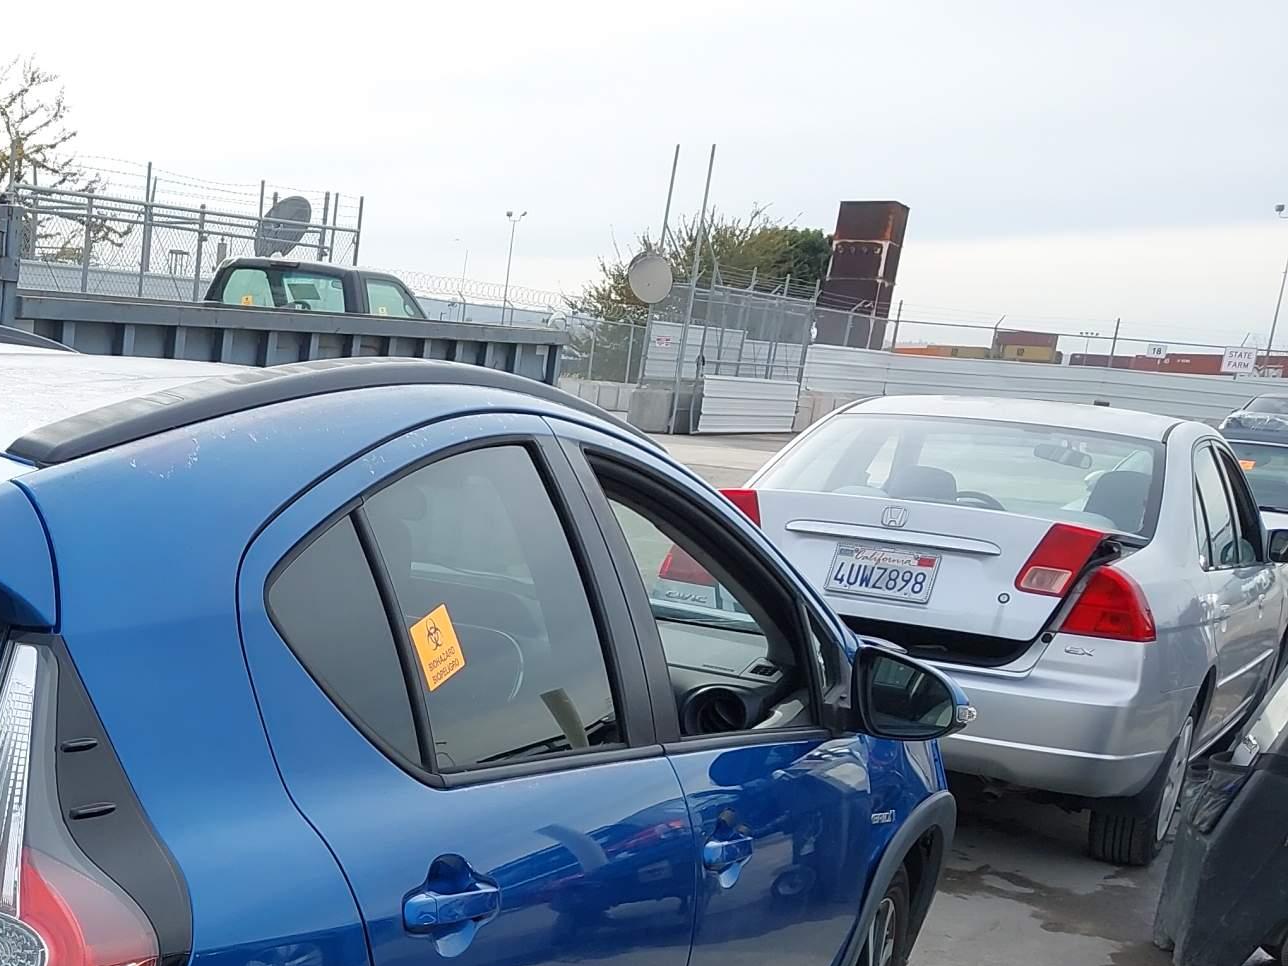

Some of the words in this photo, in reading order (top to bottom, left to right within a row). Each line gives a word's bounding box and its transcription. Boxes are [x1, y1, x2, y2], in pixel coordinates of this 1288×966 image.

[1152, 347, 1162, 355] 18
[1228, 350, 1254, 360] STATE
[1226, 360, 1249, 369] FARM
[854, 546, 912, 567] California
[833, 561, 927, 595] 4UWZ898
[665, 589, 709, 604] CIVIC
[427, 645, 456, 672] BIOHAZARD
[431, 657, 460, 685] BIOPELIGRO
